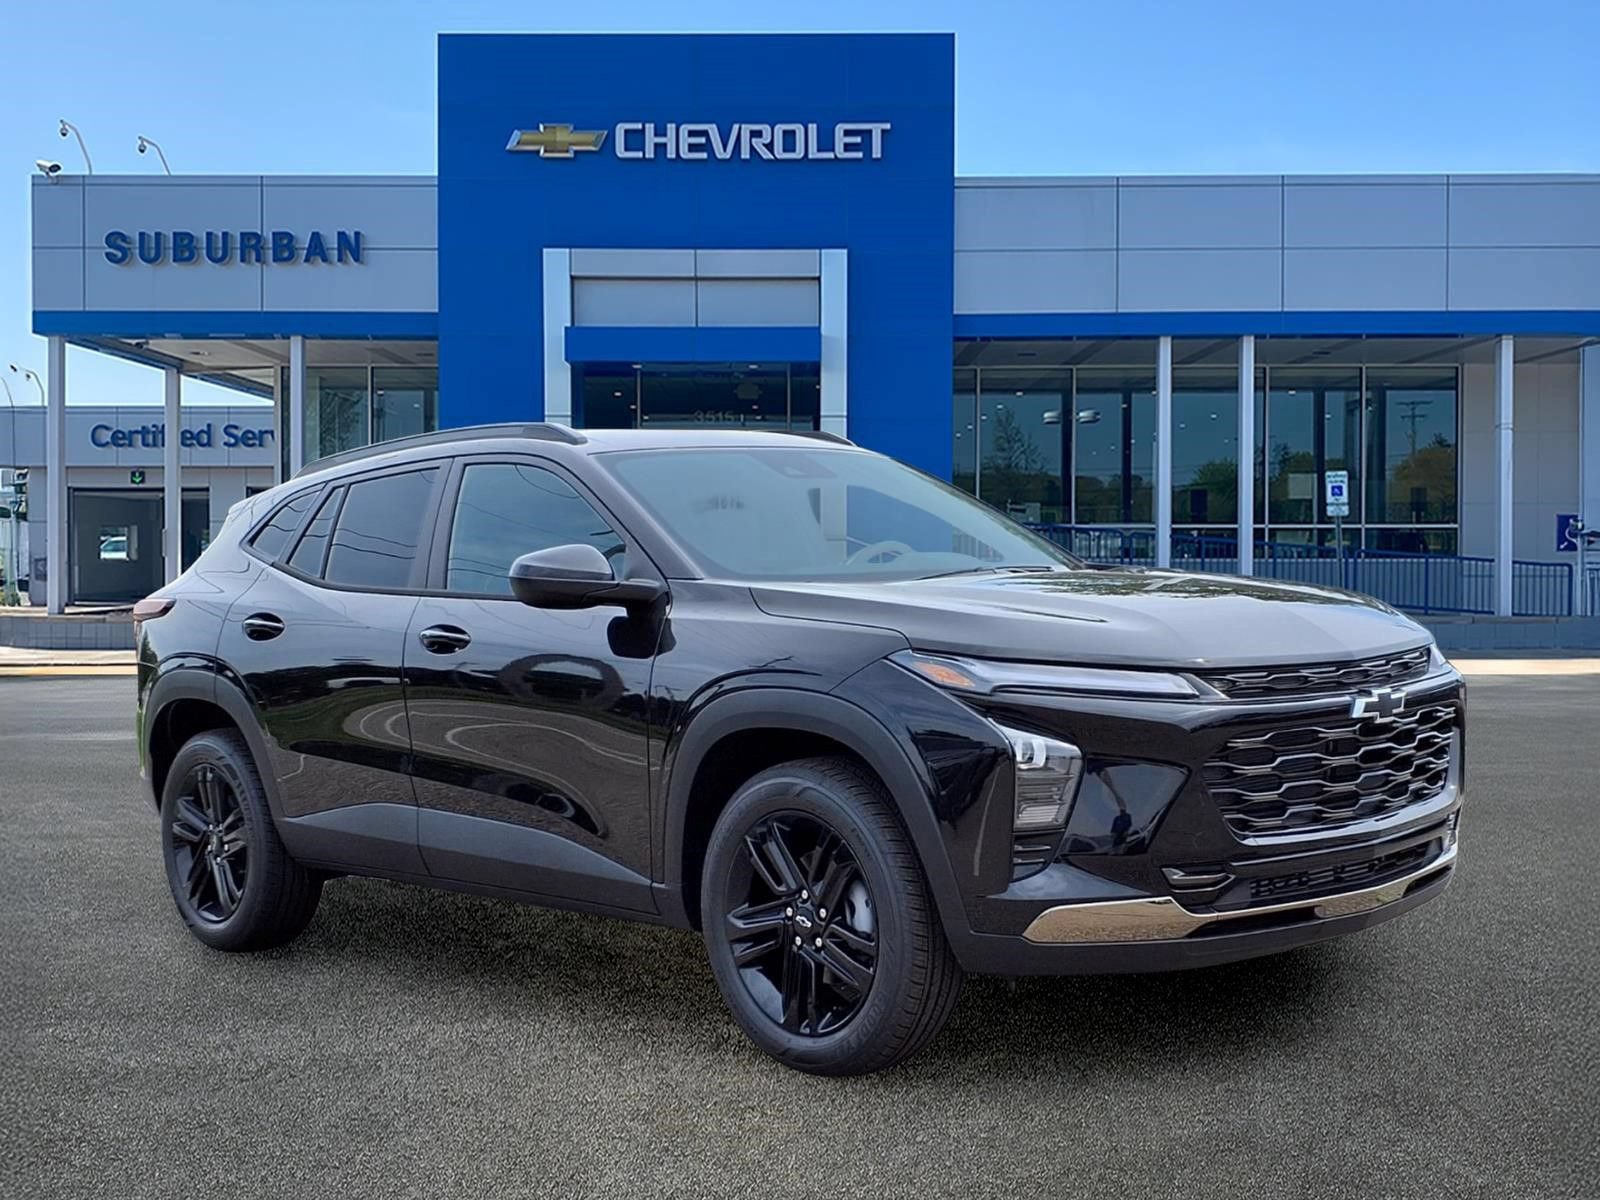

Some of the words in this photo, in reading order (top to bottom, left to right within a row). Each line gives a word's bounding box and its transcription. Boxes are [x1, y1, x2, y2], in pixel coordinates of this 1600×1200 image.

[615, 122, 892, 160] CHEVROLET
[104, 230, 363, 265] SUBURBAN
[90, 422, 212, 449] Certifed
